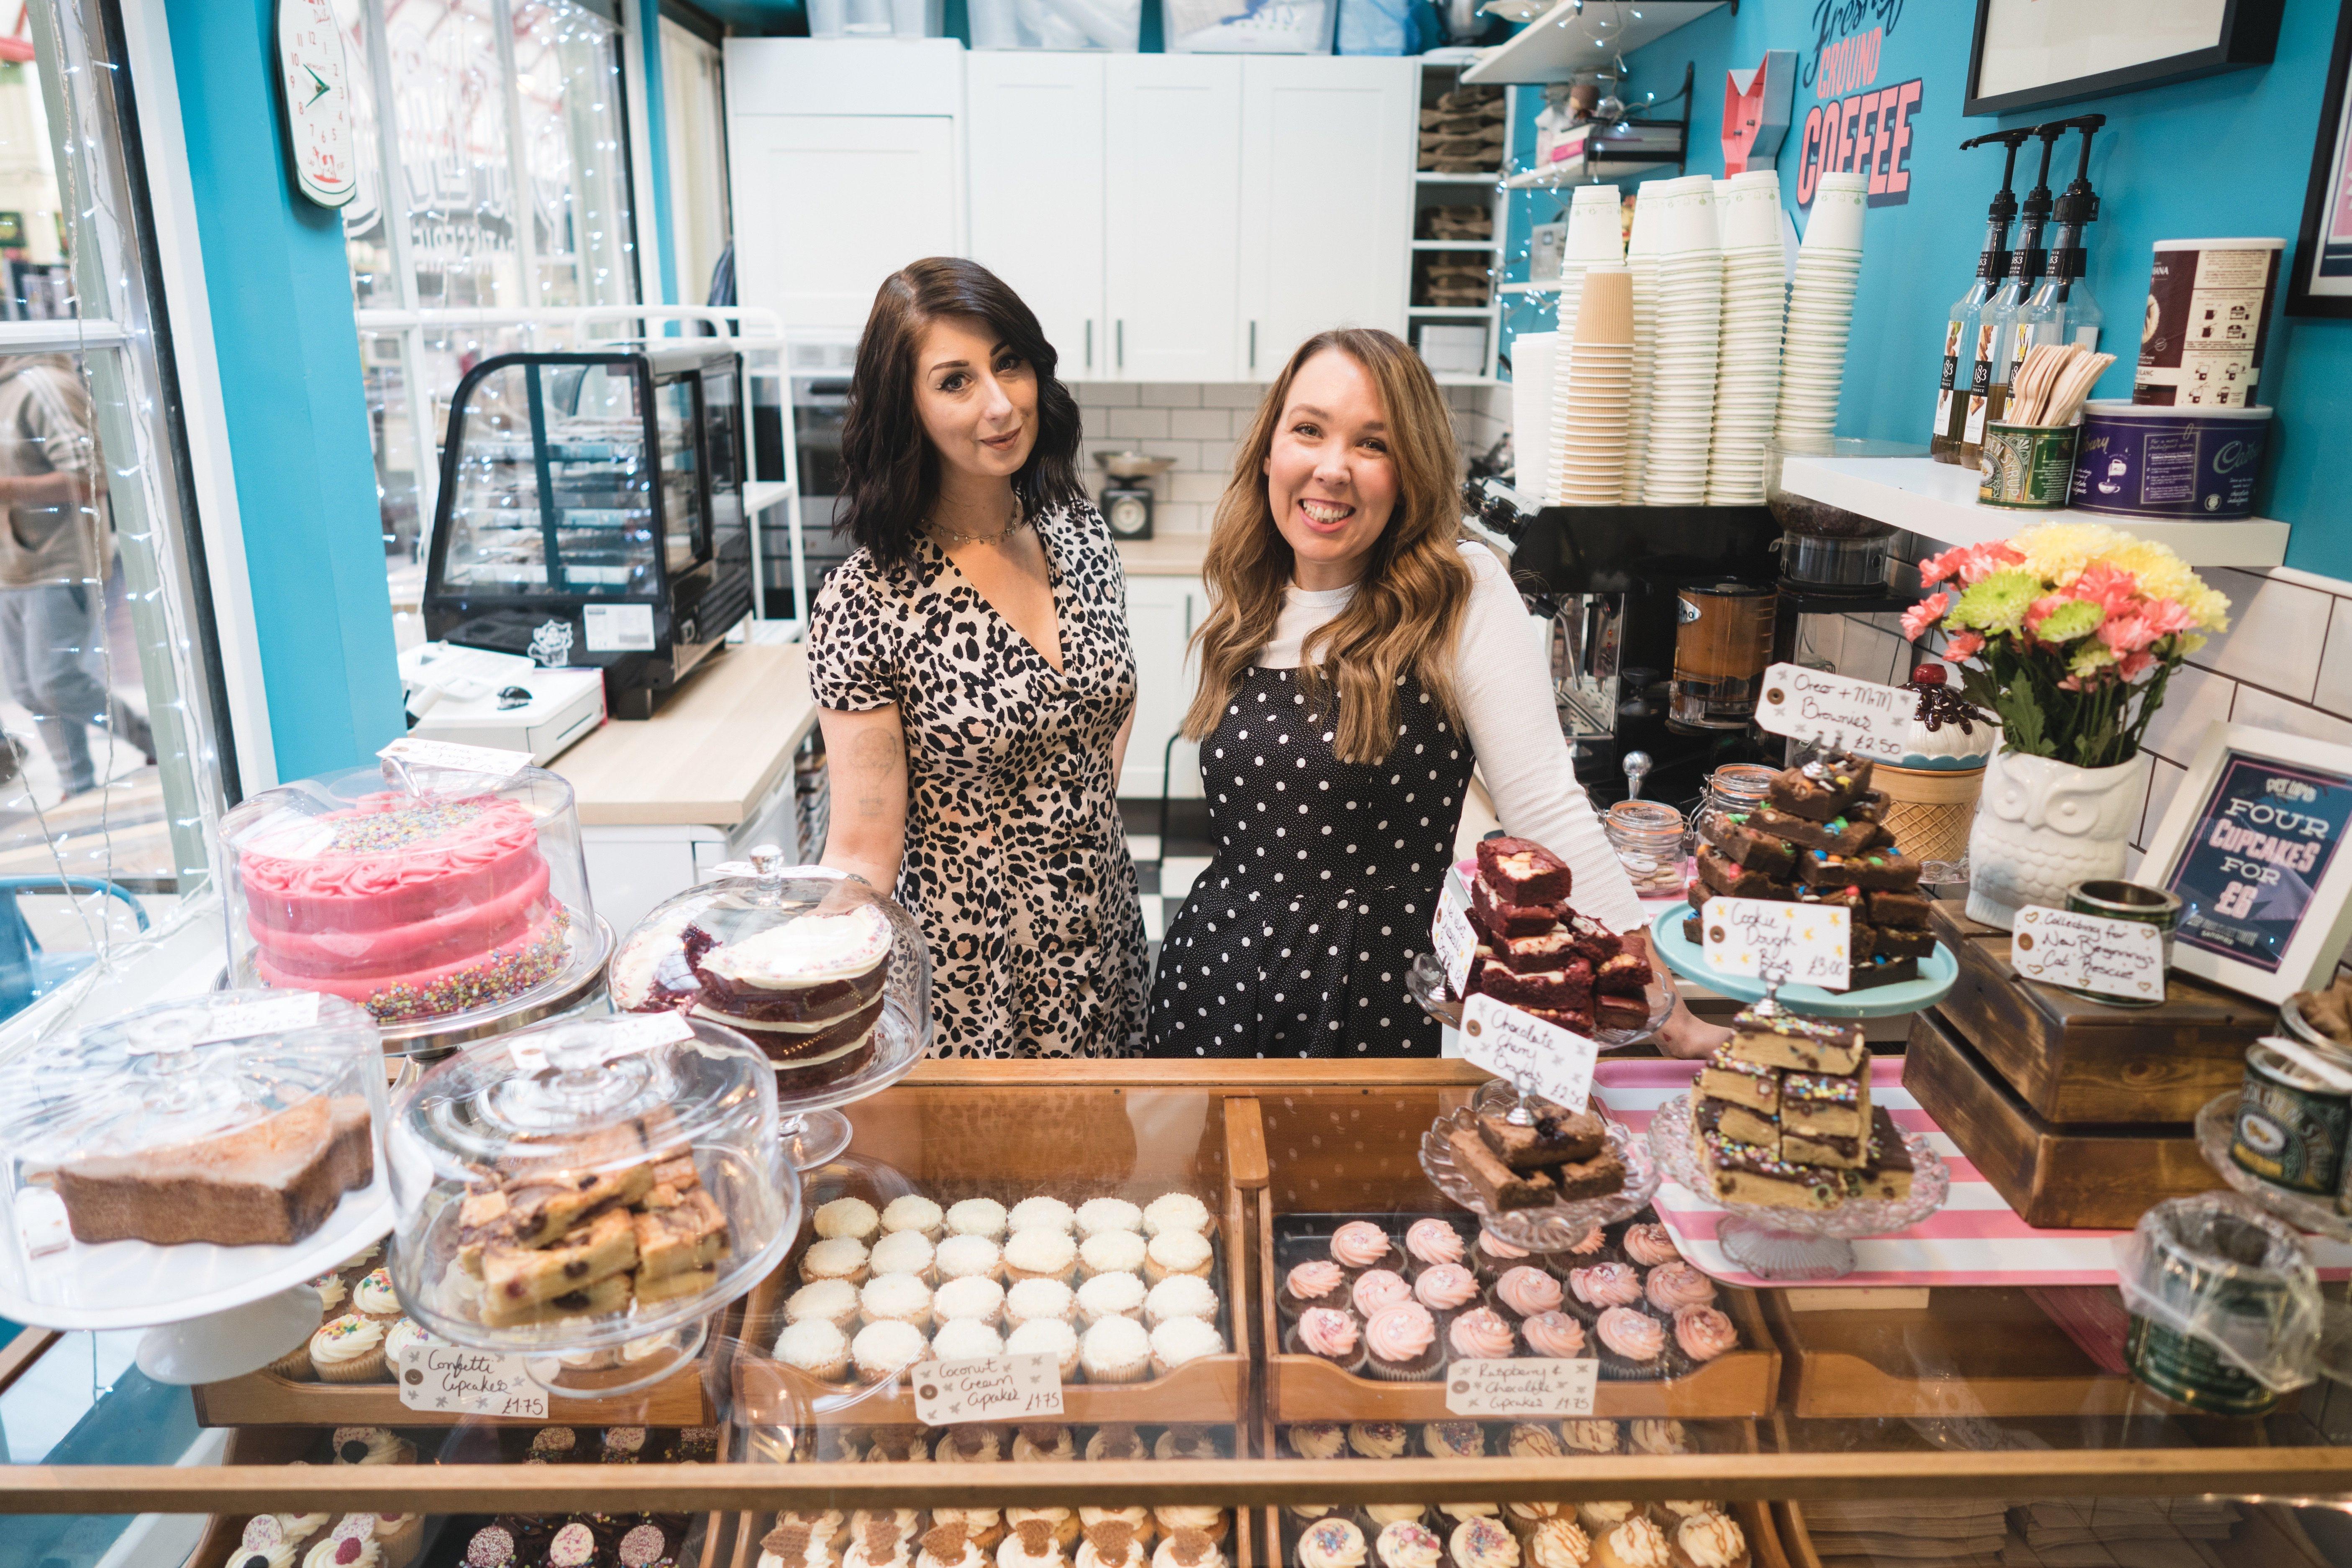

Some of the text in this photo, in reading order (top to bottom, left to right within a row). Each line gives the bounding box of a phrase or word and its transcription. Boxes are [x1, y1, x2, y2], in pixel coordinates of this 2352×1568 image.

[1817, 26, 1882, 100] GROUND
[1796, 77, 1924, 210] COFFEE
[2049, 256, 2058, 264] 83
[1985, 437, 2005, 456] DEN
[2001, 453, 2020, 496] SYRUP
[1795, 673, 1835, 694] Oreo
[1838, 688, 1851, 699] +
[1801, 696, 1871, 732] Brownies
[2224, 797, 2330, 840] FOUR
[2209, 818, 2321, 874] CUPCAKES
[2219, 856, 2281, 886] FOR
[1731, 901, 1778, 929] Cookie
[2214, 880, 2258, 920] £6
[1746, 924, 1798, 959] Dough
[2105, 923, 2128, 939] for
[2043, 949, 2070, 967] Cat
[1491, 1008, 1555, 1051] Chocolate
[428, 1348, 495, 1379] Confetti
[939, 1358, 998, 1378] Coconut
[1479, 1363, 1546, 1382] Raspberry
[442, 1373, 512, 1397] Cupcakes
[961, 1374, 1014, 1391] Cream
[502, 1397, 543, 1415] £1.75
